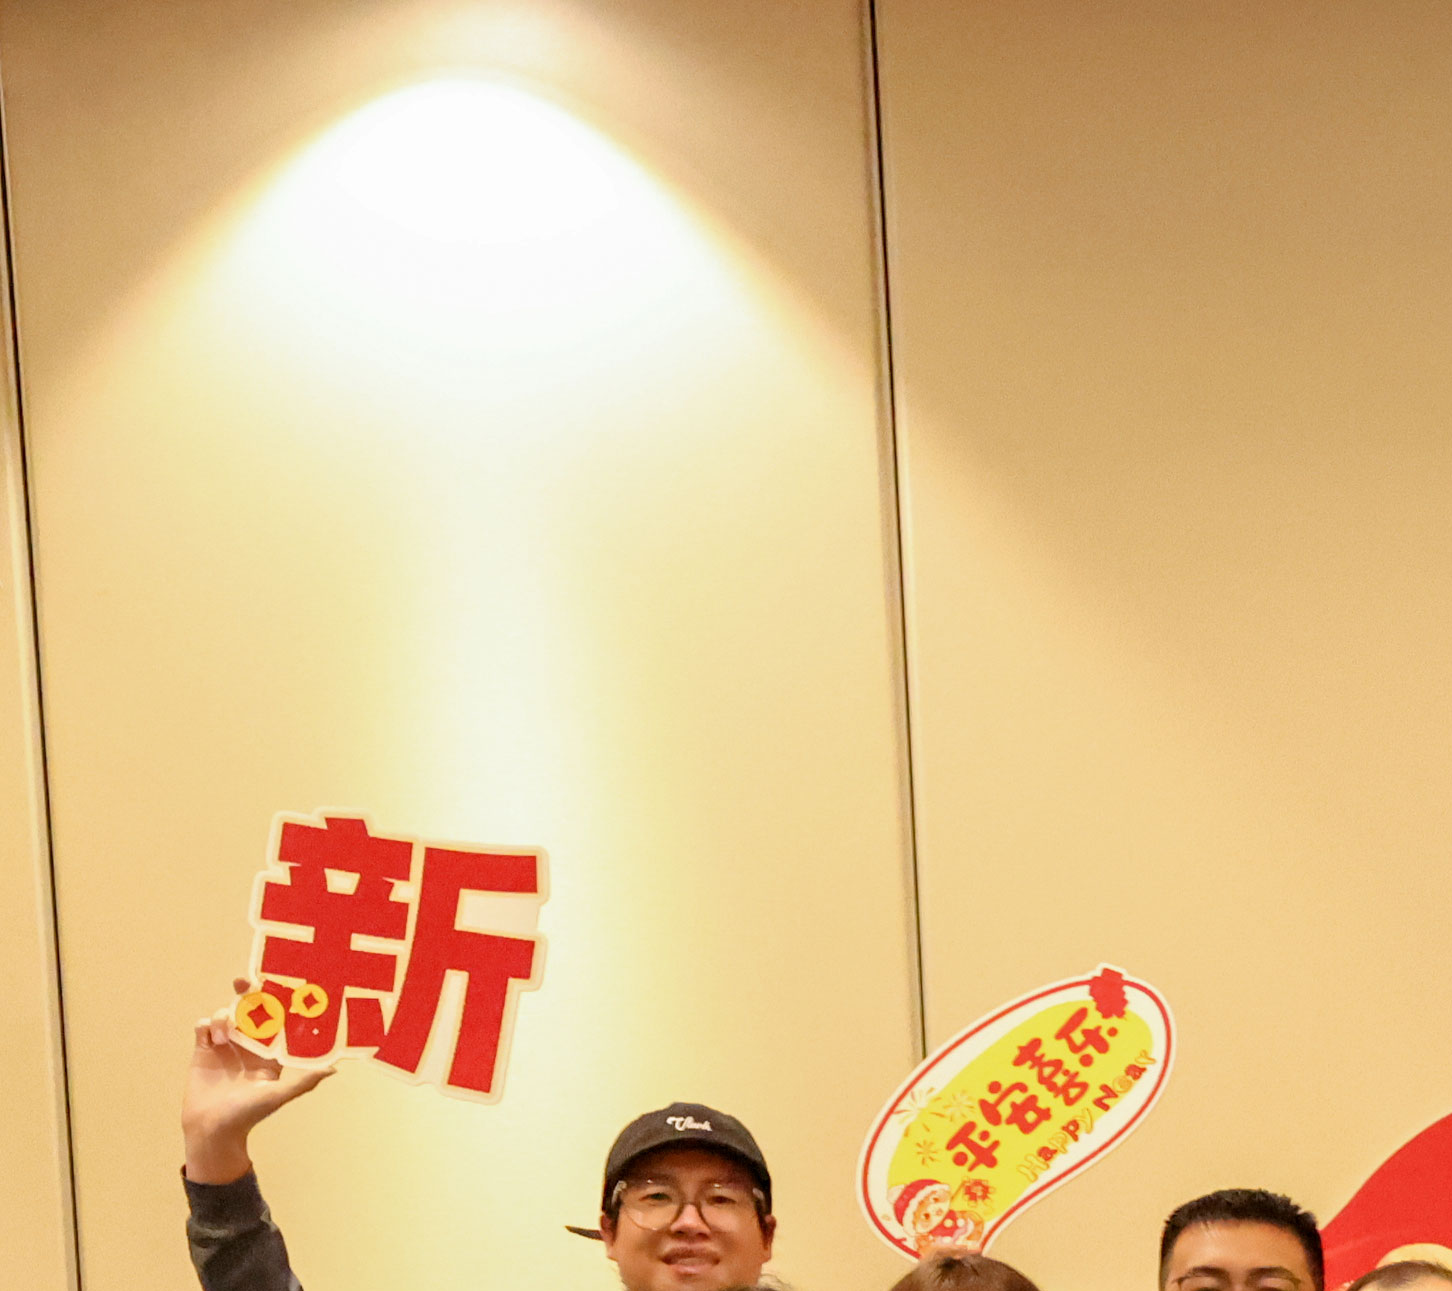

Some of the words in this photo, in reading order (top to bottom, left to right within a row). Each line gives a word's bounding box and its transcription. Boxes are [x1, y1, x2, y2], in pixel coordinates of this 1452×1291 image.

[258, 817, 537, 1093] 新
[946, 1007, 1118, 1172] 平安喜乐
[1016, 1108, 1095, 1183] Happy
